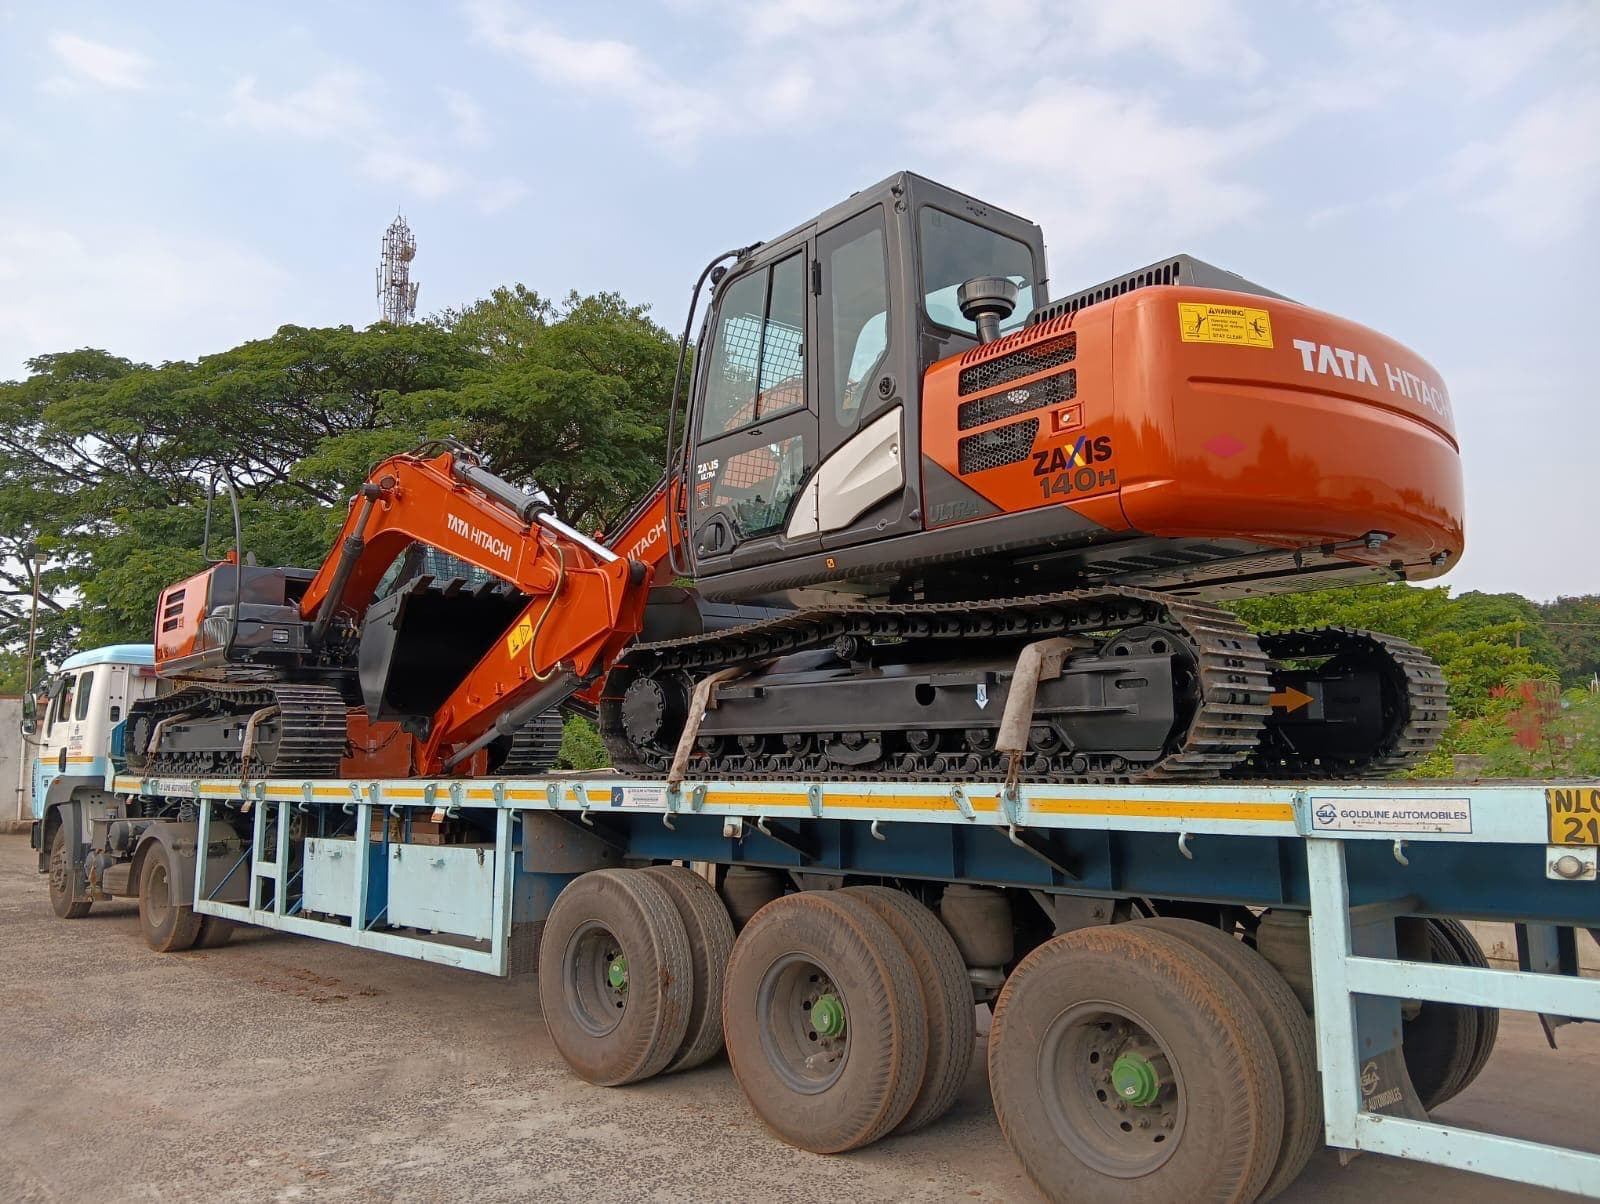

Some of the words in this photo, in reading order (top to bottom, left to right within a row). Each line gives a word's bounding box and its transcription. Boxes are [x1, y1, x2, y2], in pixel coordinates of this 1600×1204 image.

[1214, 308, 1244, 316] WARNING
[1292, 338, 1379, 387] TATA
[1383, 362, 1450, 419] HITACH
[697, 459, 719, 475] ZAXIS
[1032, 435, 1113, 477] ZAXIS
[700, 470, 716, 480] ULTRA
[1039, 467, 1116, 499] 140H
[928, 500, 980, 522] ULTRA
[447, 513, 469, 539] TATA
[470, 526, 512, 562] HITACHI
[627, 515, 667, 561] ITACH
[1340, 810, 1390, 819] GOLDLINE
[1392, 811, 1468, 820] AUTOMOBILES
